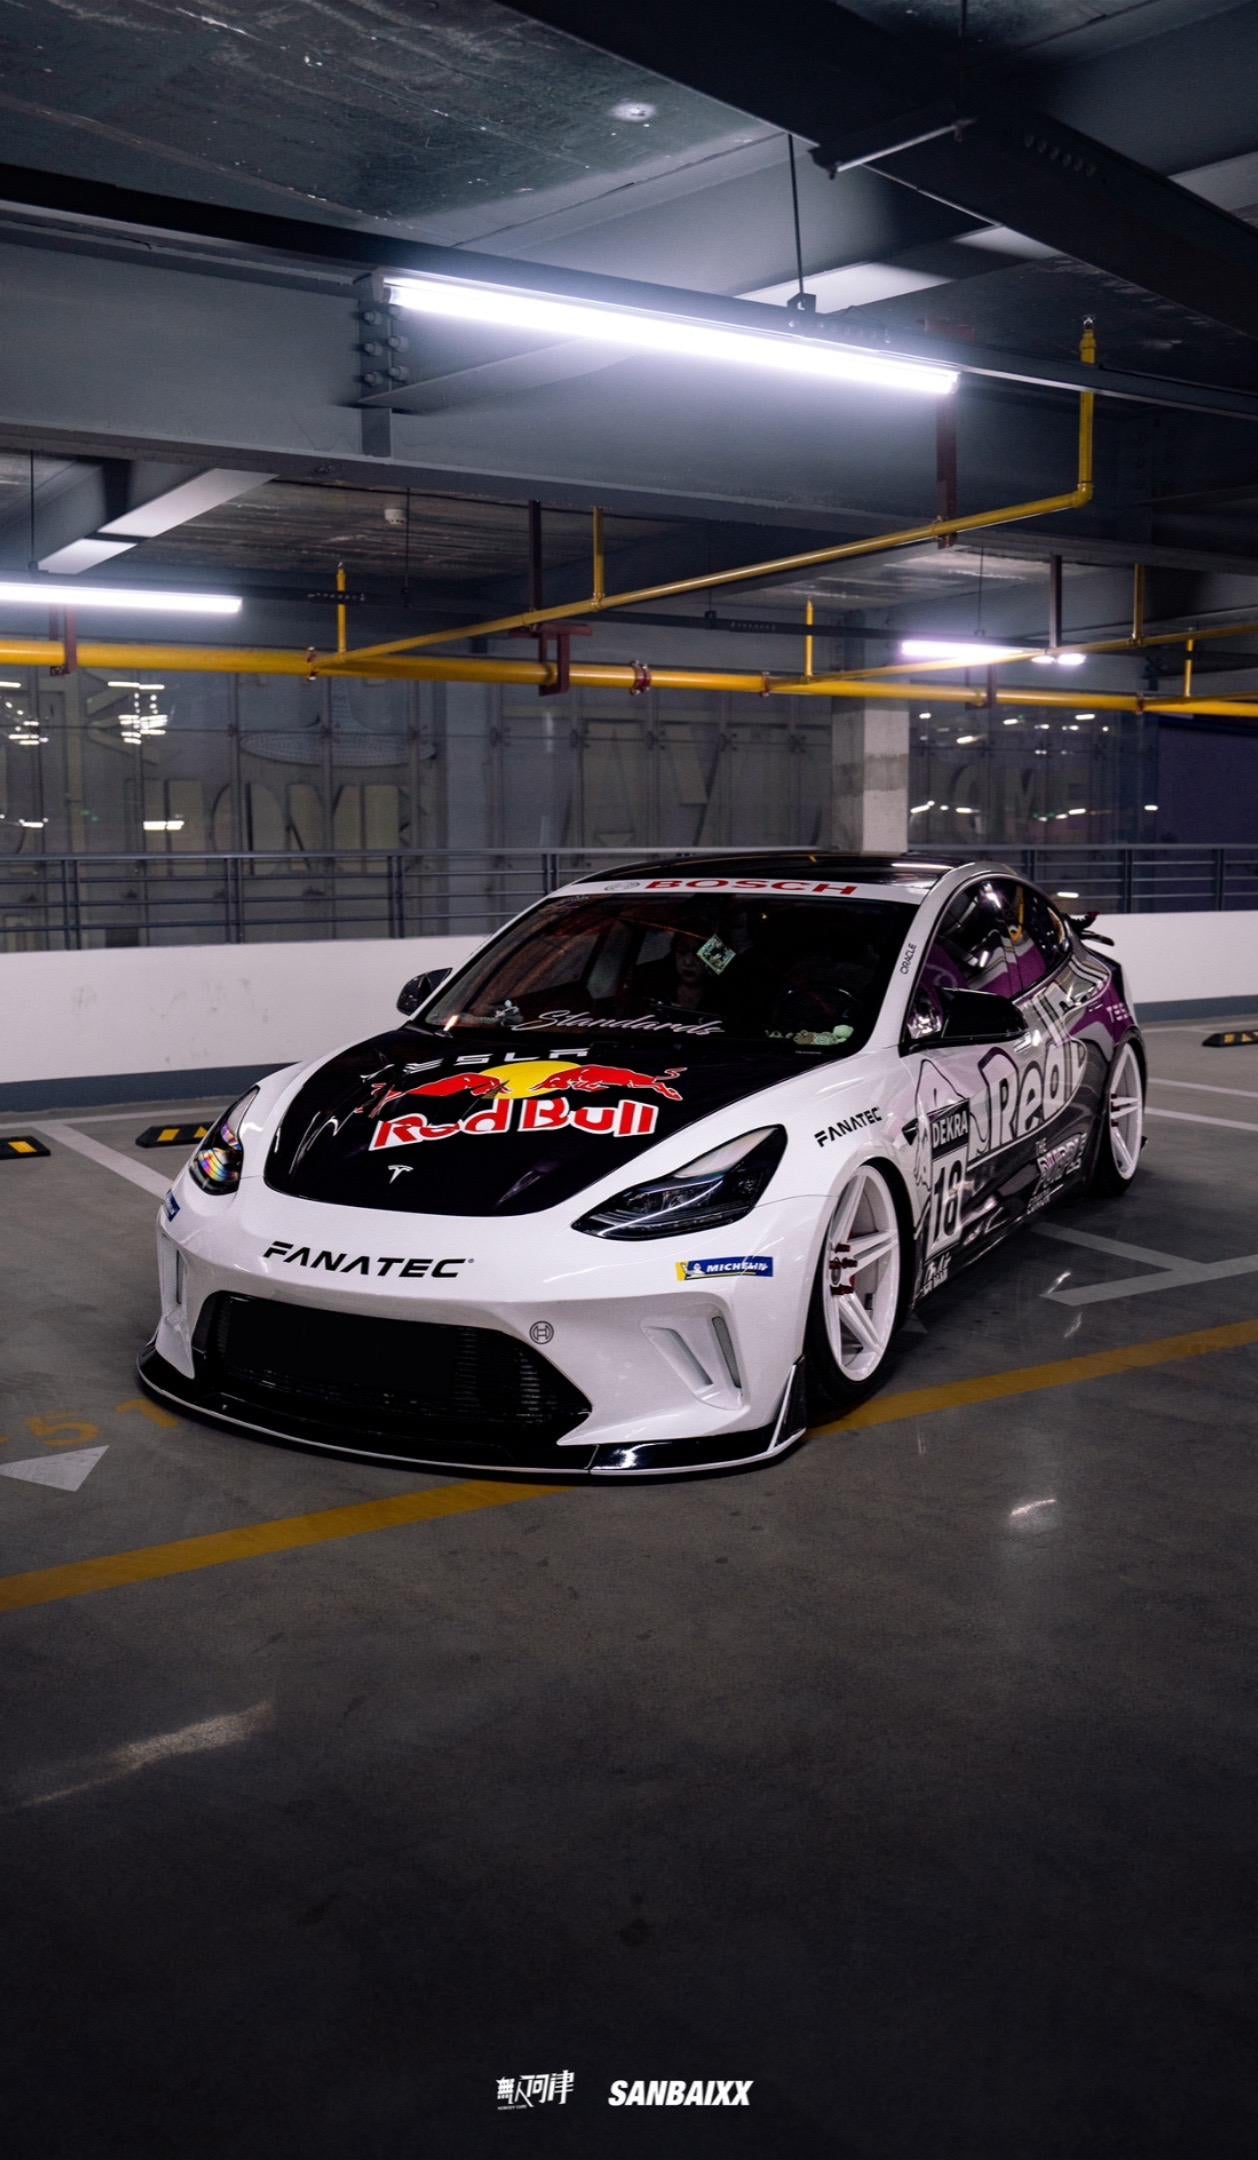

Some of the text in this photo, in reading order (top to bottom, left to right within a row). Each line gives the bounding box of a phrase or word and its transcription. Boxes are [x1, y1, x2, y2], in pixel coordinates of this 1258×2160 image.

[645, 879, 858, 895] BOSCH
[900, 942, 917, 975] ORACLE
[511, 1010, 725, 1036] Standards
[368, 1097, 659, 1150] Red Bull
[814, 1106, 883, 1148] FANATEC
[932, 1110, 969, 1148] DEKRA
[933, 1159, 963, 1245] 18
[263, 1240, 467, 1278] FANATEC
